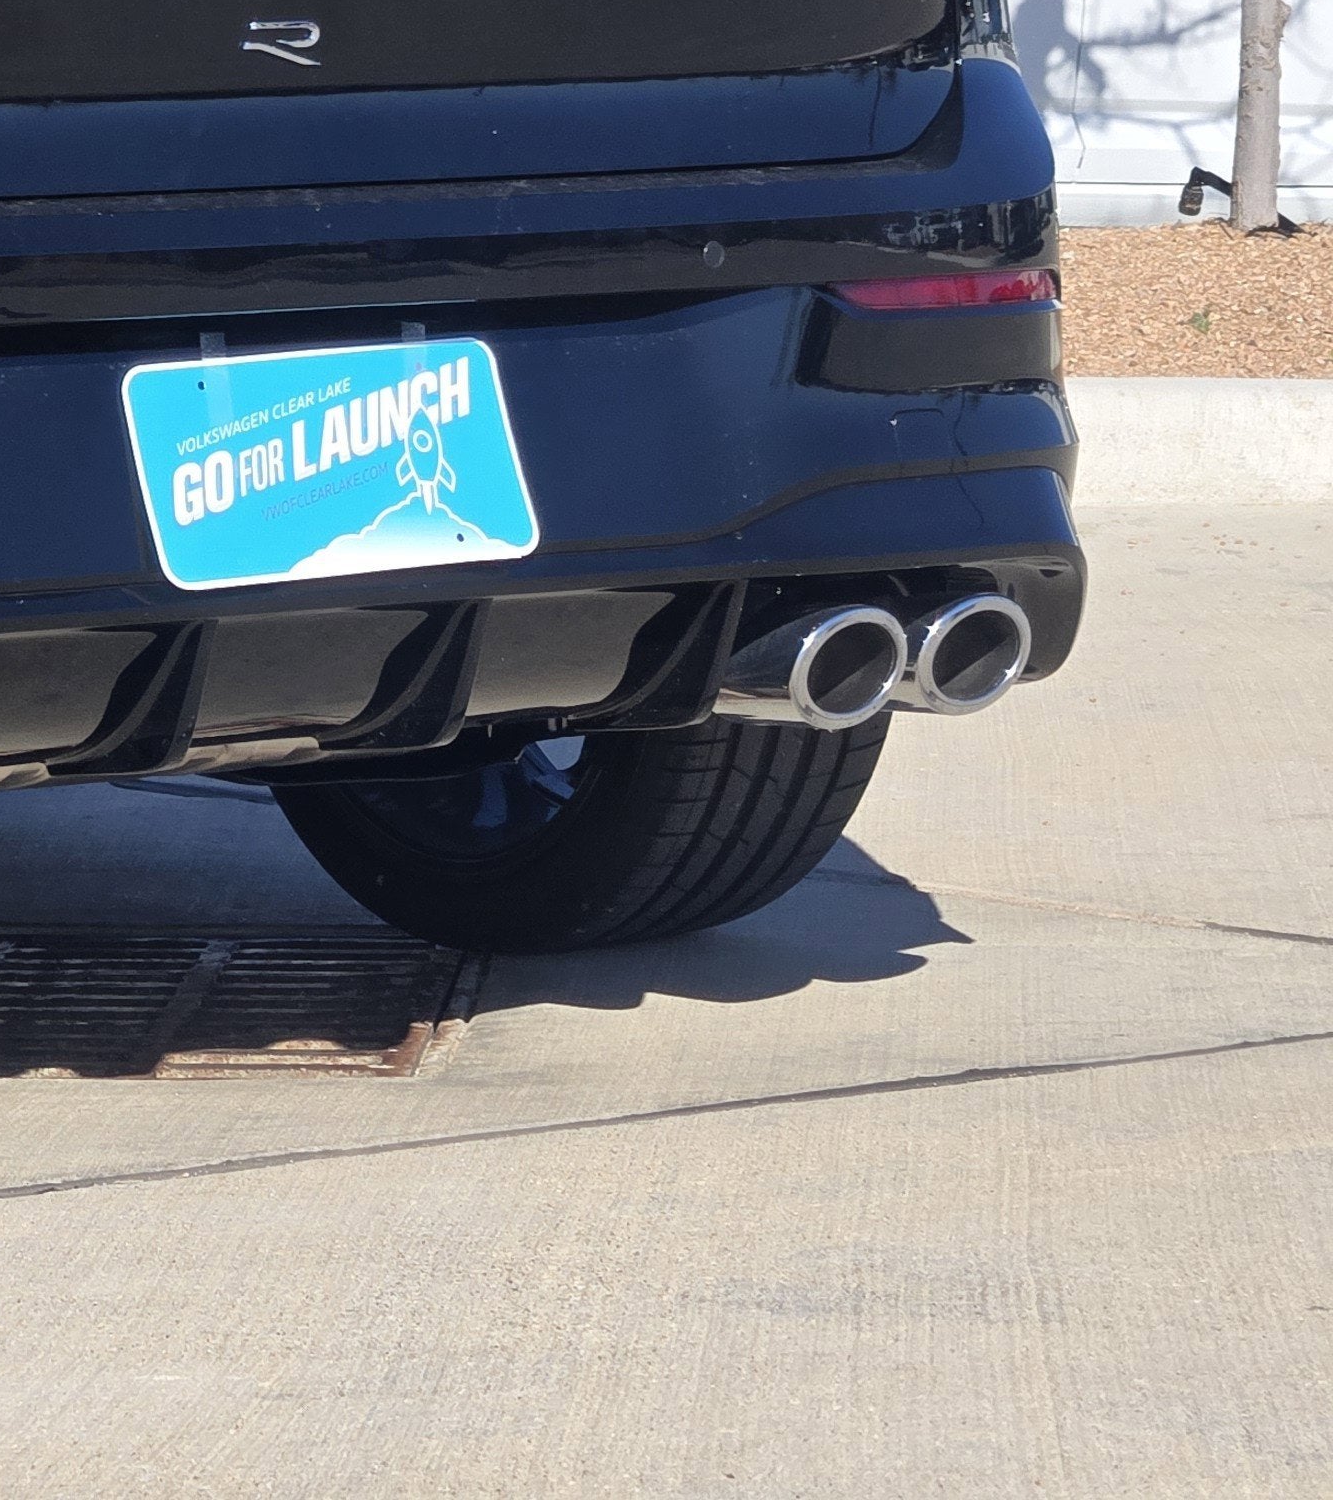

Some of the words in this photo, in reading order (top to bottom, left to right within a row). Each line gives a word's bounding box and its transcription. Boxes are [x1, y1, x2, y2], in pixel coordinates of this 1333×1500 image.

[173, 450, 234, 526] GO
[239, 438, 285, 497] FOR
[292, 356, 470, 481] LAUNCH
[176, 409, 269, 456] VOLKSWAGEN
[272, 391, 315, 420] CLEAR
[318, 377, 351, 403] LAKE
